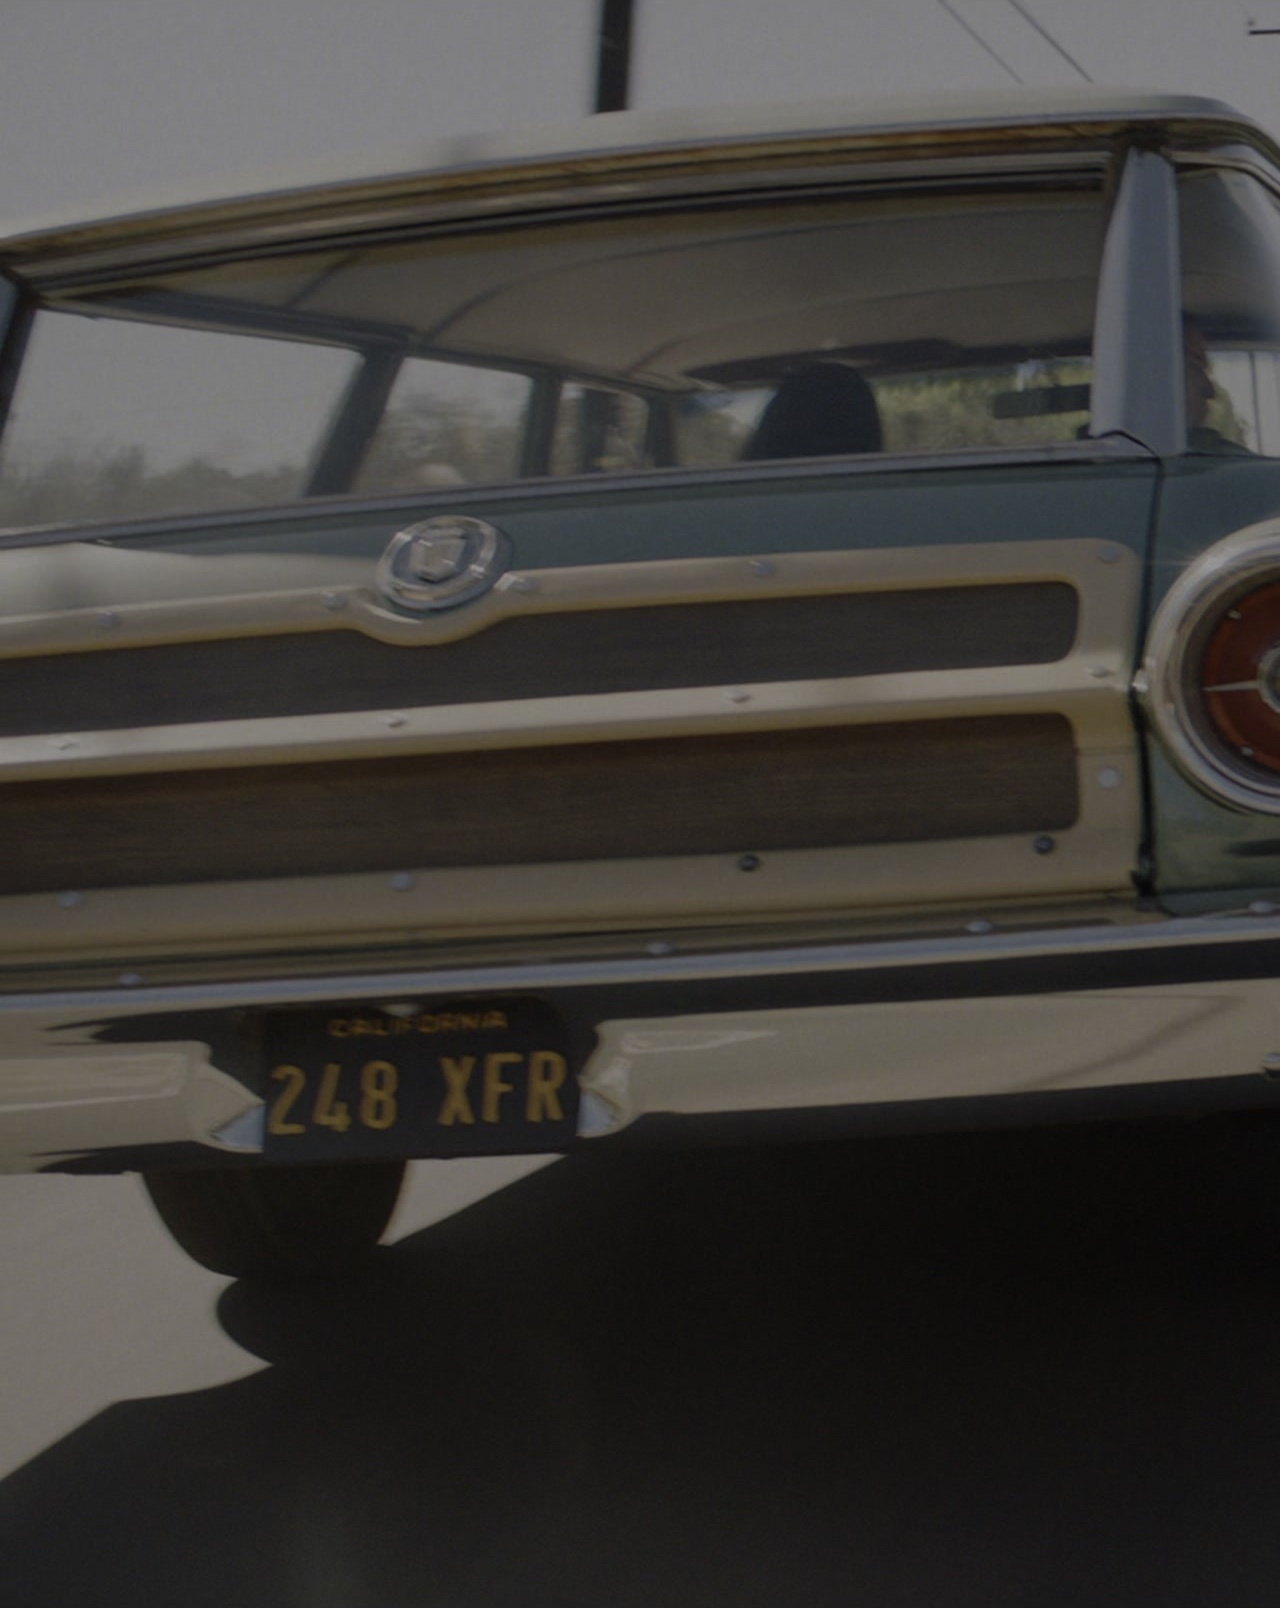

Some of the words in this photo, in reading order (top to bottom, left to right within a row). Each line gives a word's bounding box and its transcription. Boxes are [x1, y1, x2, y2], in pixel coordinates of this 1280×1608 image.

[328, 1011, 507, 1037] CALIFORNIA
[268, 1060, 398, 1135] 248
[437, 1051, 567, 1126] XFR
